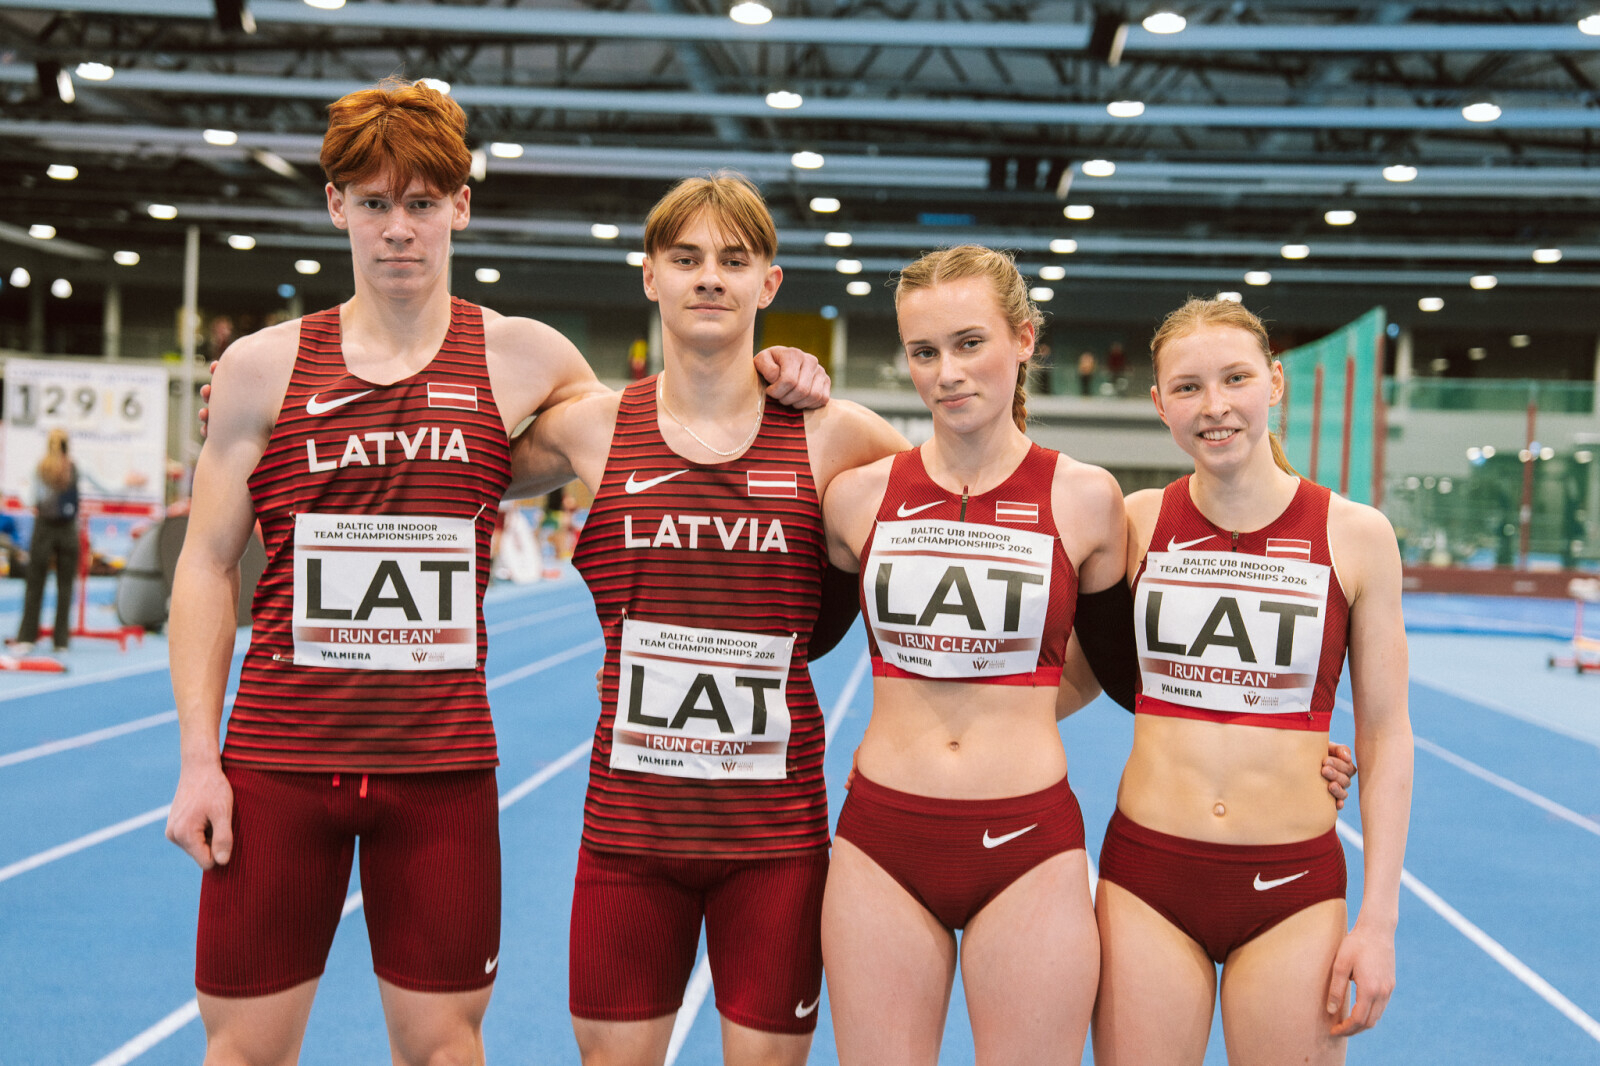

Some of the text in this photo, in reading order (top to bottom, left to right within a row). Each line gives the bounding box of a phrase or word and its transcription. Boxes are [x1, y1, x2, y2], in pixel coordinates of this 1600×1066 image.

[306, 427, 470, 473] LATVIA
[337, 522, 438, 532] BALTIC U18 INDOOR
[624, 514, 788, 553] LATVIA
[911, 527, 1011, 542] BALTIC U18 INDOOR
[314, 531, 343, 539] TEAM
[346, 532, 434, 541] CHAMPIONSHIPS
[890, 536, 1032, 554] TEAM CHAMPIONSHIPS 2026
[1183, 558, 1285, 573] BALTIC U18 INDOOR
[1160, 565, 1307, 586] TEAM CHAMPIONSHIPS 2026
[306, 558, 470, 622] LAT
[875, 563, 1044, 632] LAT
[338, 629, 374, 643] RUN
[1146, 590, 1318, 666] LAT
[640, 638, 775, 660] TEAM CHAMPIONSHIPS 2026
[660, 632, 758, 649] BALTIC U18 INDOOR
[906, 634, 936, 650] RUN
[320, 650, 371, 660] VALMIERA
[1174, 664, 1206, 681] RUN
[1162, 683, 1202, 698] VALMIERA
[627, 664, 782, 735] LAT
[652, 736, 688, 752] RUN
[637, 754, 684, 767] VALMIERA
